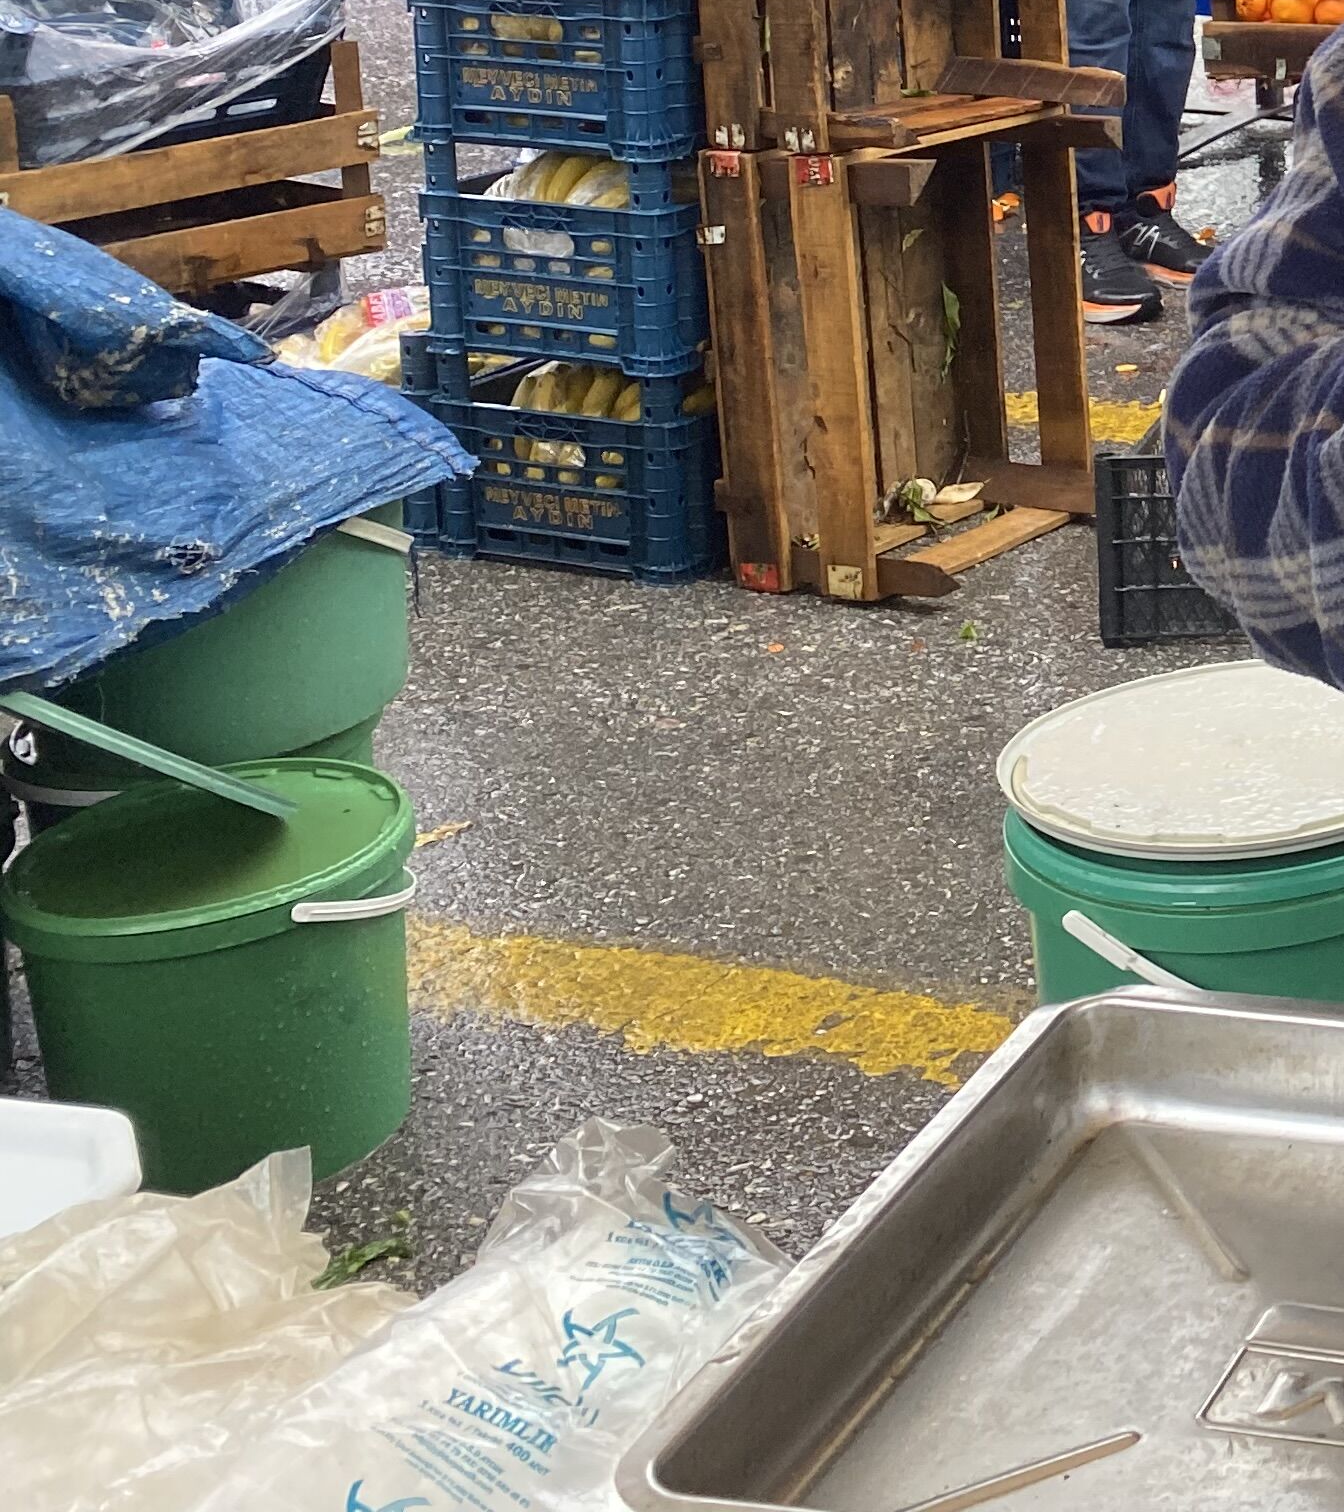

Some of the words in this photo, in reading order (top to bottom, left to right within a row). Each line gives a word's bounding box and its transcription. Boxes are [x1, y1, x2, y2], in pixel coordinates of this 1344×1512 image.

[490, 85, 573, 106] AYDIN
[502, 297, 584, 320] AYDIN
[512, 505, 594, 529] AYDIN
